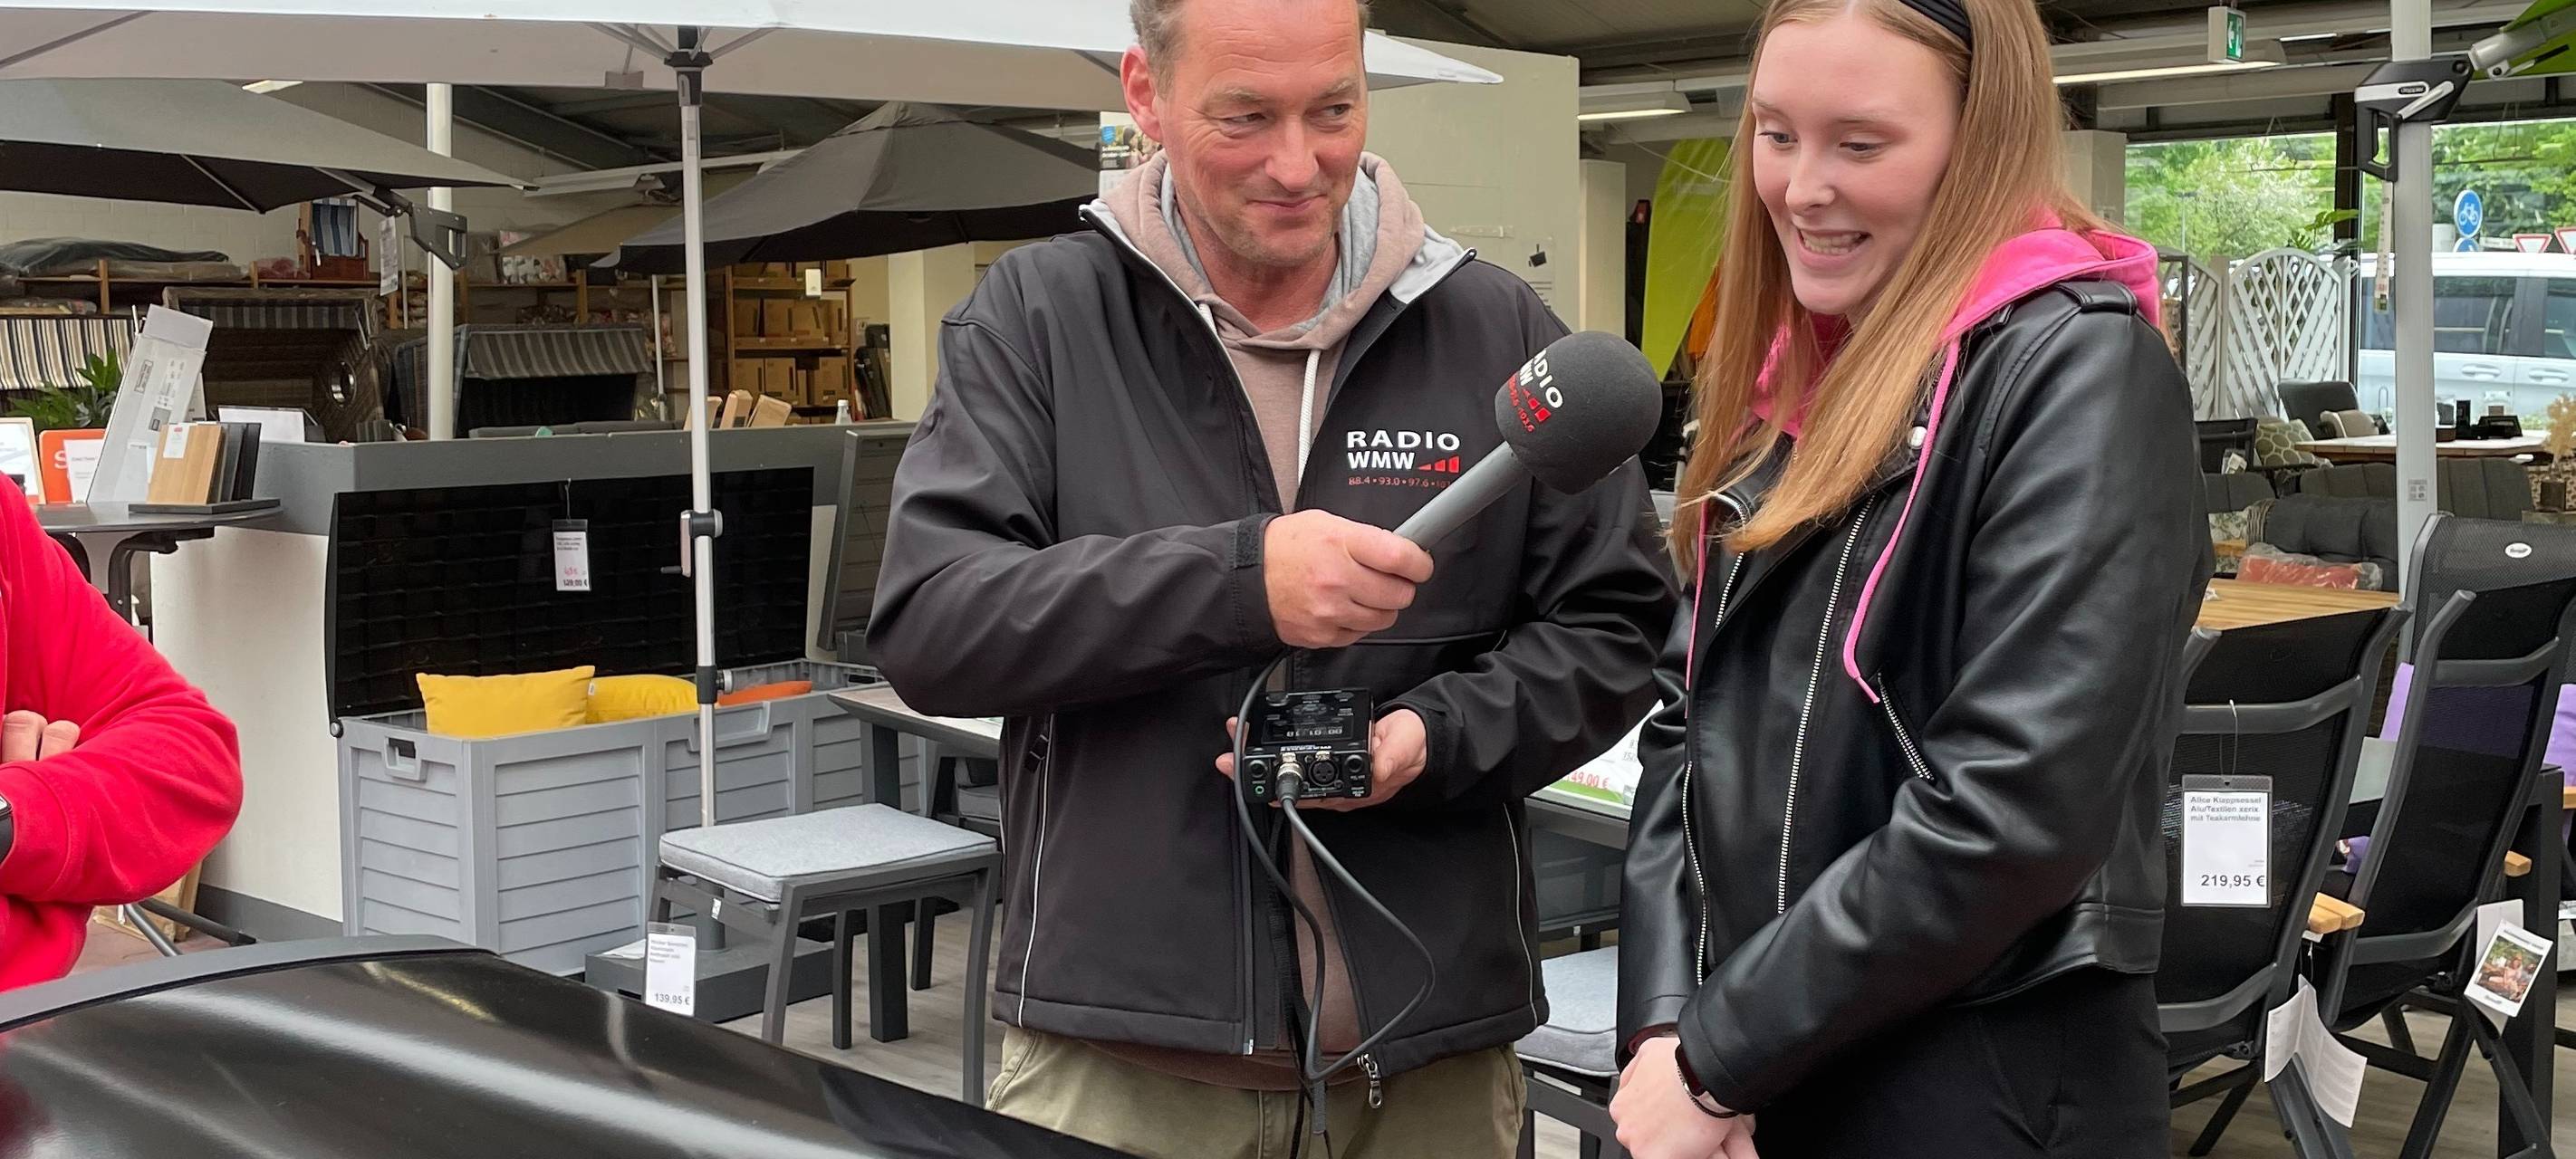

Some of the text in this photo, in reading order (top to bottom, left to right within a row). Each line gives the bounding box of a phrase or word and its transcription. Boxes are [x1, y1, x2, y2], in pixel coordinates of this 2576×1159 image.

[1533, 350, 1563, 408] ADIO
[1347, 430, 1460, 451] RADIO
[1347, 451, 1415, 469] WMW
[1348, 476, 1370, 485] 88.4
[1378, 477, 1400, 486] 93.0
[1408, 478, 1428, 487] 97.6
[1602, 777, 1609, 789] €
[2214, 797, 2261, 805] Klappsessel
[2201, 875, 2265, 888] 219,95 €
[655, 992, 690, 1006] 139,95 €
